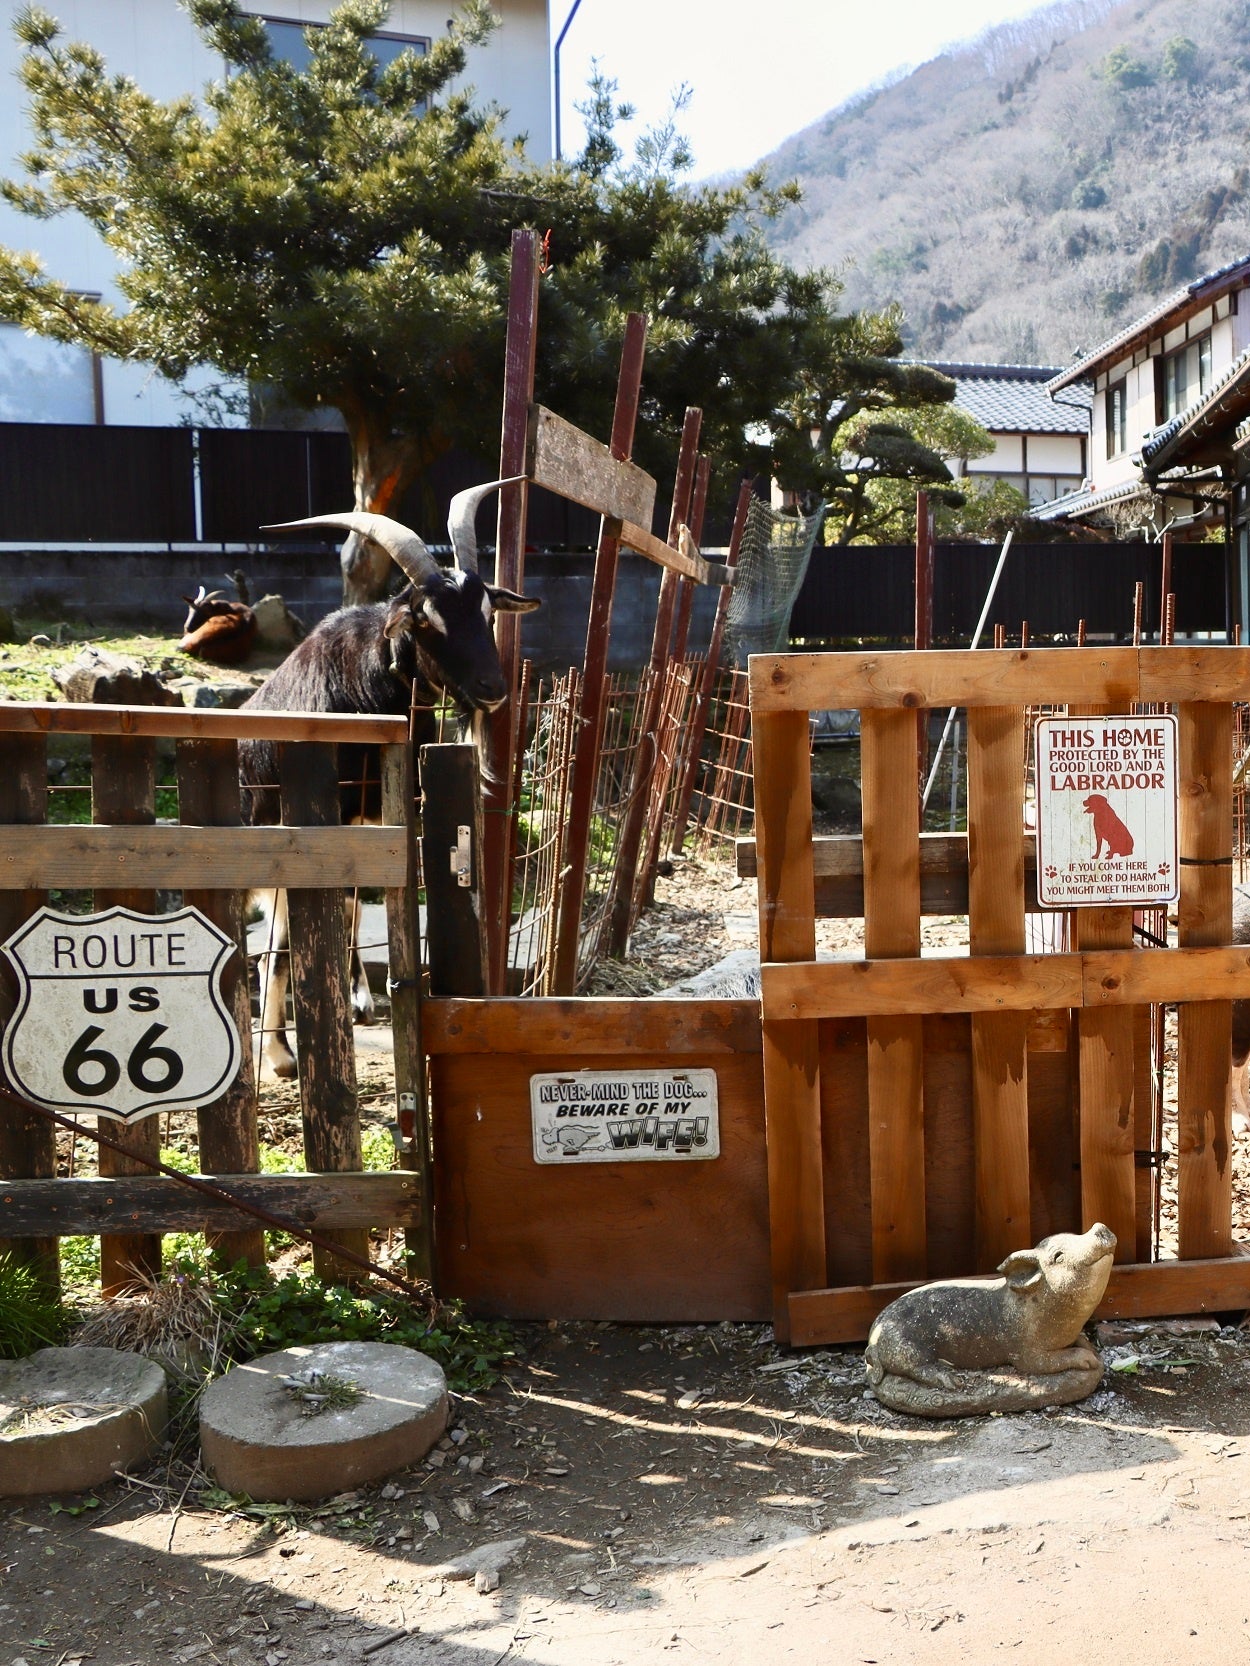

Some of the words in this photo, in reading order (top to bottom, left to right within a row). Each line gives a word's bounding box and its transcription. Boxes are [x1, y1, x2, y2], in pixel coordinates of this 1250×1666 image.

[1049, 729, 1095, 748] THIS
[1050, 750, 1118, 761] PROTECTED
[1123, 749, 1139, 760] BY
[1142, 749, 1165, 760] THE
[1050, 762, 1085, 773] GOOD
[1090, 761, 1122, 772] LORD
[1126, 761, 1152, 771] AND
[1156, 761, 1165, 771] A
[1051, 773, 1165, 791] LABRADOR
[1069, 863, 1076, 871] IF
[1077, 863, 1096, 871] YOU
[1098, 862, 1124, 871] COME
[1126, 862, 1147, 870] HERE
[1061, 875, 1072, 883] TO
[1074, 874, 1099, 883] STEAL
[1101, 874, 1113, 882] OR
[1115, 873, 1128, 882] DO
[1130, 873, 1156, 882] HARM
[1047, 887, 1065, 895] YOU
[1067, 886, 1094, 895] MIGHT
[1096, 885, 1120, 894] MEET
[1122, 885, 1145, 893] THEM
[1147, 884, 1170, 893] BOTH
[54, 933, 186, 969] ROUTE
[83, 986, 160, 1013] US
[63, 1023, 184, 1096] 66
[540, 1082, 629, 1103] NEVER-MIND
[632, 1082, 659, 1099] THE
[664, 1081, 707, 1099] DOG...
[556, 1103, 630, 1117] BEWARE
[635, 1102, 659, 1115] OF
[664, 1102, 691, 1114] MY
[606, 1116, 709, 1150] WIFE!
